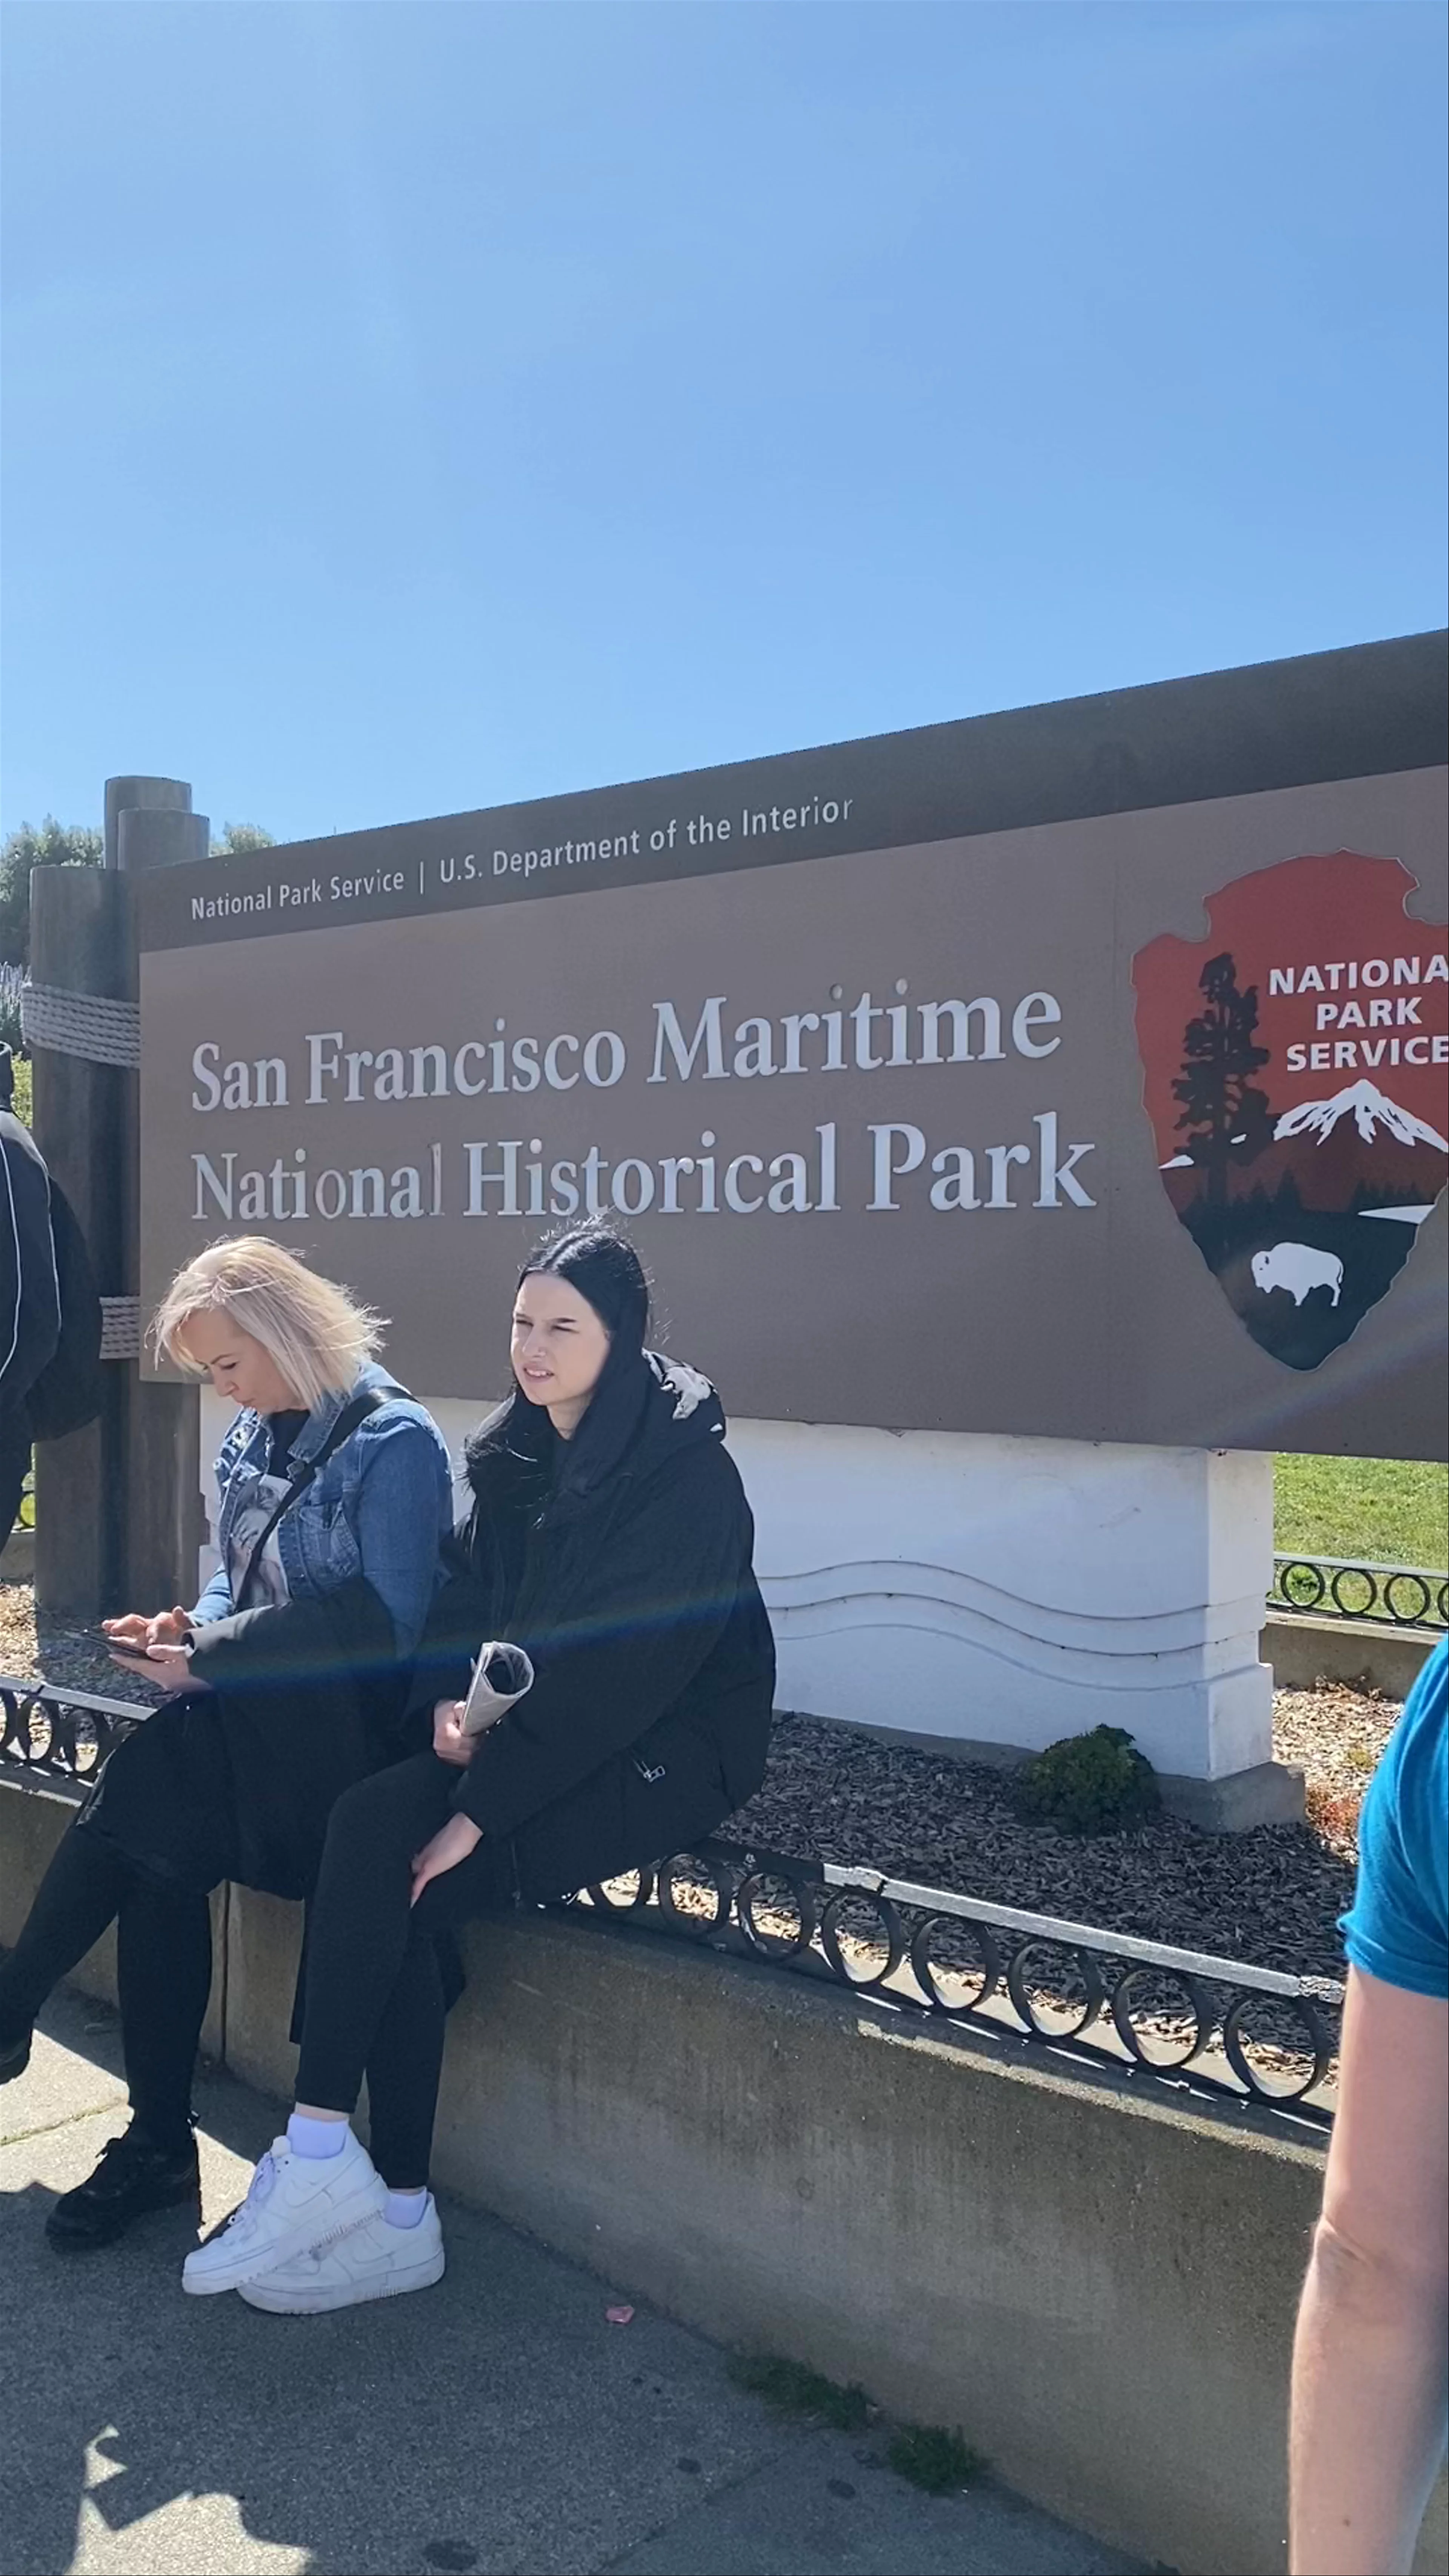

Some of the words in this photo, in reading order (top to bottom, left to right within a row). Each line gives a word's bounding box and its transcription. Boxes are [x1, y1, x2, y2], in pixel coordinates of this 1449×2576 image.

[191, 886, 271, 920] National
[279, 878, 322, 907] Park
[330, 869, 405, 900] Service
[440, 854, 482, 883] U.S.
[493, 830, 640, 877] Department
[650, 819, 677, 851] of
[687, 815, 731, 845] the
[743, 796, 853, 836] Interior
[1269, 954, 1449, 995] NATIONA
[192, 1042, 289, 1111] San
[305, 1017, 627, 1104] Francisco
[646, 978, 1062, 1083] Maritime
[1316, 997, 1422, 1030] PARK
[1287, 1035, 1449, 1071] SERVICE
[191, 1142, 446, 1220] National
[463, 1121, 841, 1217] Historical
[866, 1111, 1097, 1210] Park
